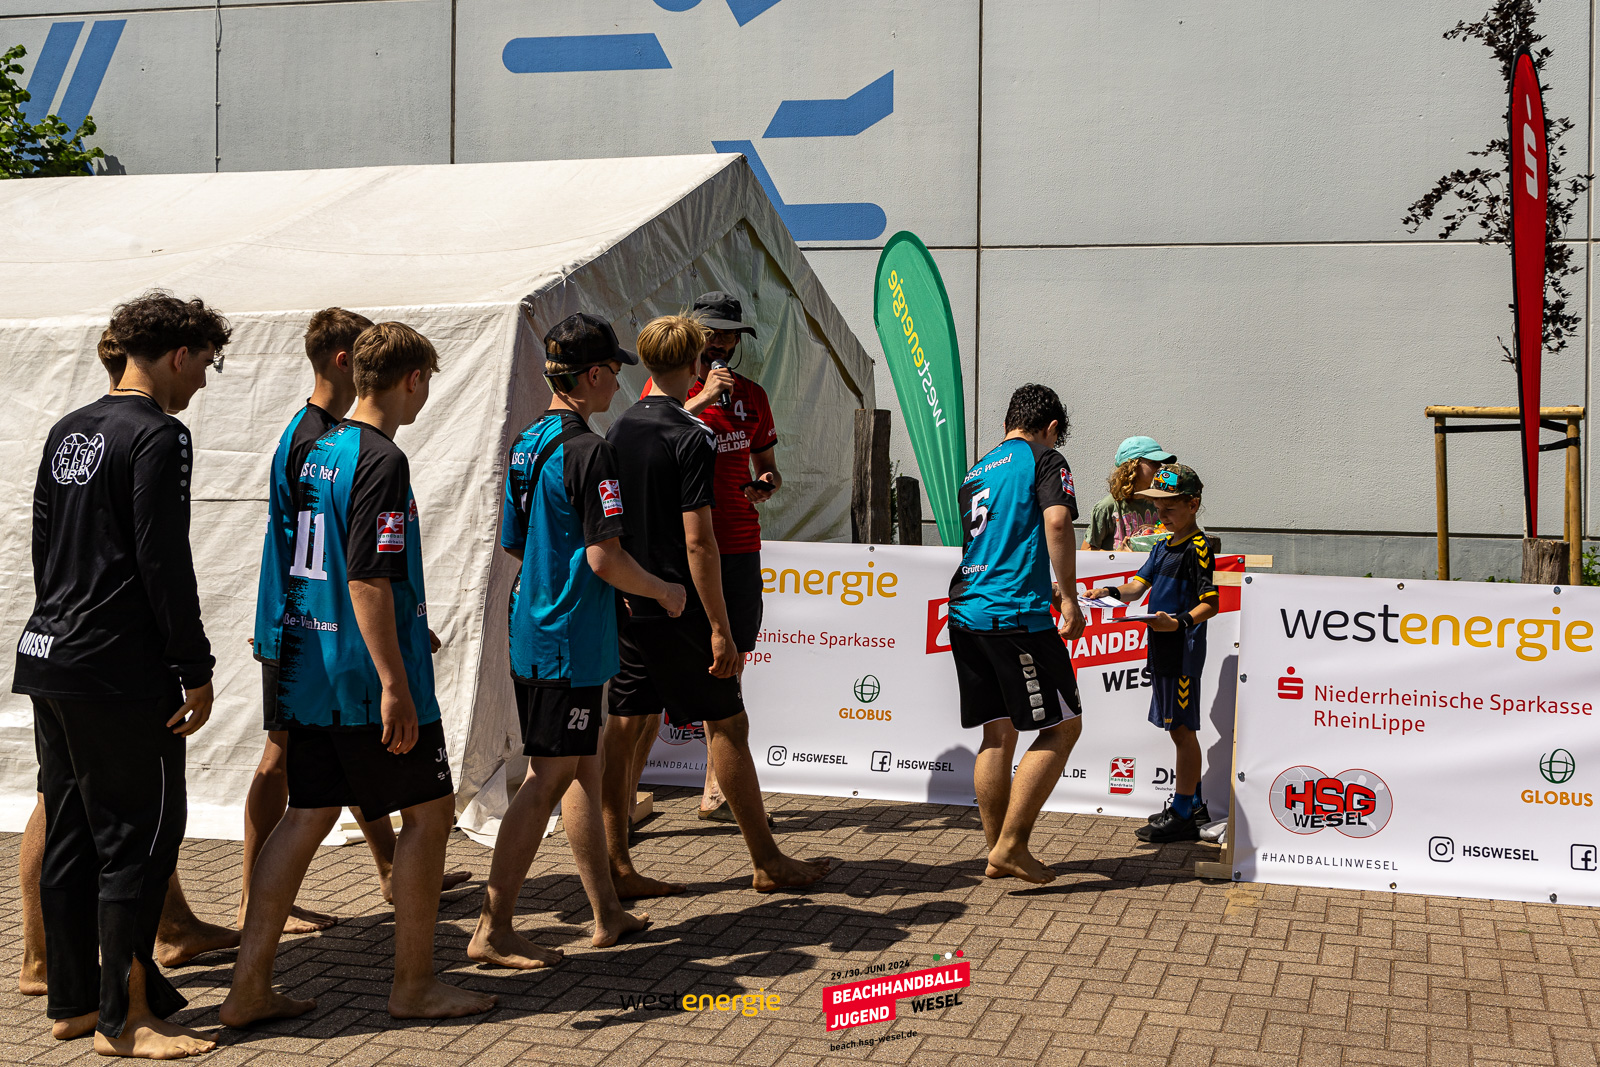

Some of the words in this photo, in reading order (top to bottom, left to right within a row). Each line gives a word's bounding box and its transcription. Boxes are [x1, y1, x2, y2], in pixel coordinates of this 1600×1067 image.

[734, 399, 748, 422] 4
[963, 466, 983, 484] HSG
[984, 452, 1013, 473] Wesel
[969, 487, 991, 539] 5
[289, 510, 328, 581] 11
[962, 563, 989, 575] Grütter
[761, 561, 898, 606] energie
[18, 630, 55, 659] MISSI
[756, 628, 816, 645] einische
[820, 632, 896, 649] Sparkasse
[1280, 604, 1594, 662] westenergie
[1102, 666, 1153, 693] WES
[1314, 685, 1485, 710] Niederrheinische
[1489, 694, 1594, 716] Sparkasse
[567, 707, 591, 731] 25
[838, 707, 893, 722] GLOBUS
[1314, 710, 1426, 735] RheinLippe
[669, 727, 706, 741] WES
[791, 752, 848, 765] HSGWESEL
[896, 758, 955, 772] HSGWESEL
[1152, 767, 1177, 785] DH
[1284, 777, 1377, 818] HSG
[1520, 789, 1594, 807] GLOBUS
[1293, 811, 1368, 829] WESEL
[1262, 852, 1399, 871] #HANDBALLINWESEL
[1462, 845, 1539, 862] HSGWESEL
